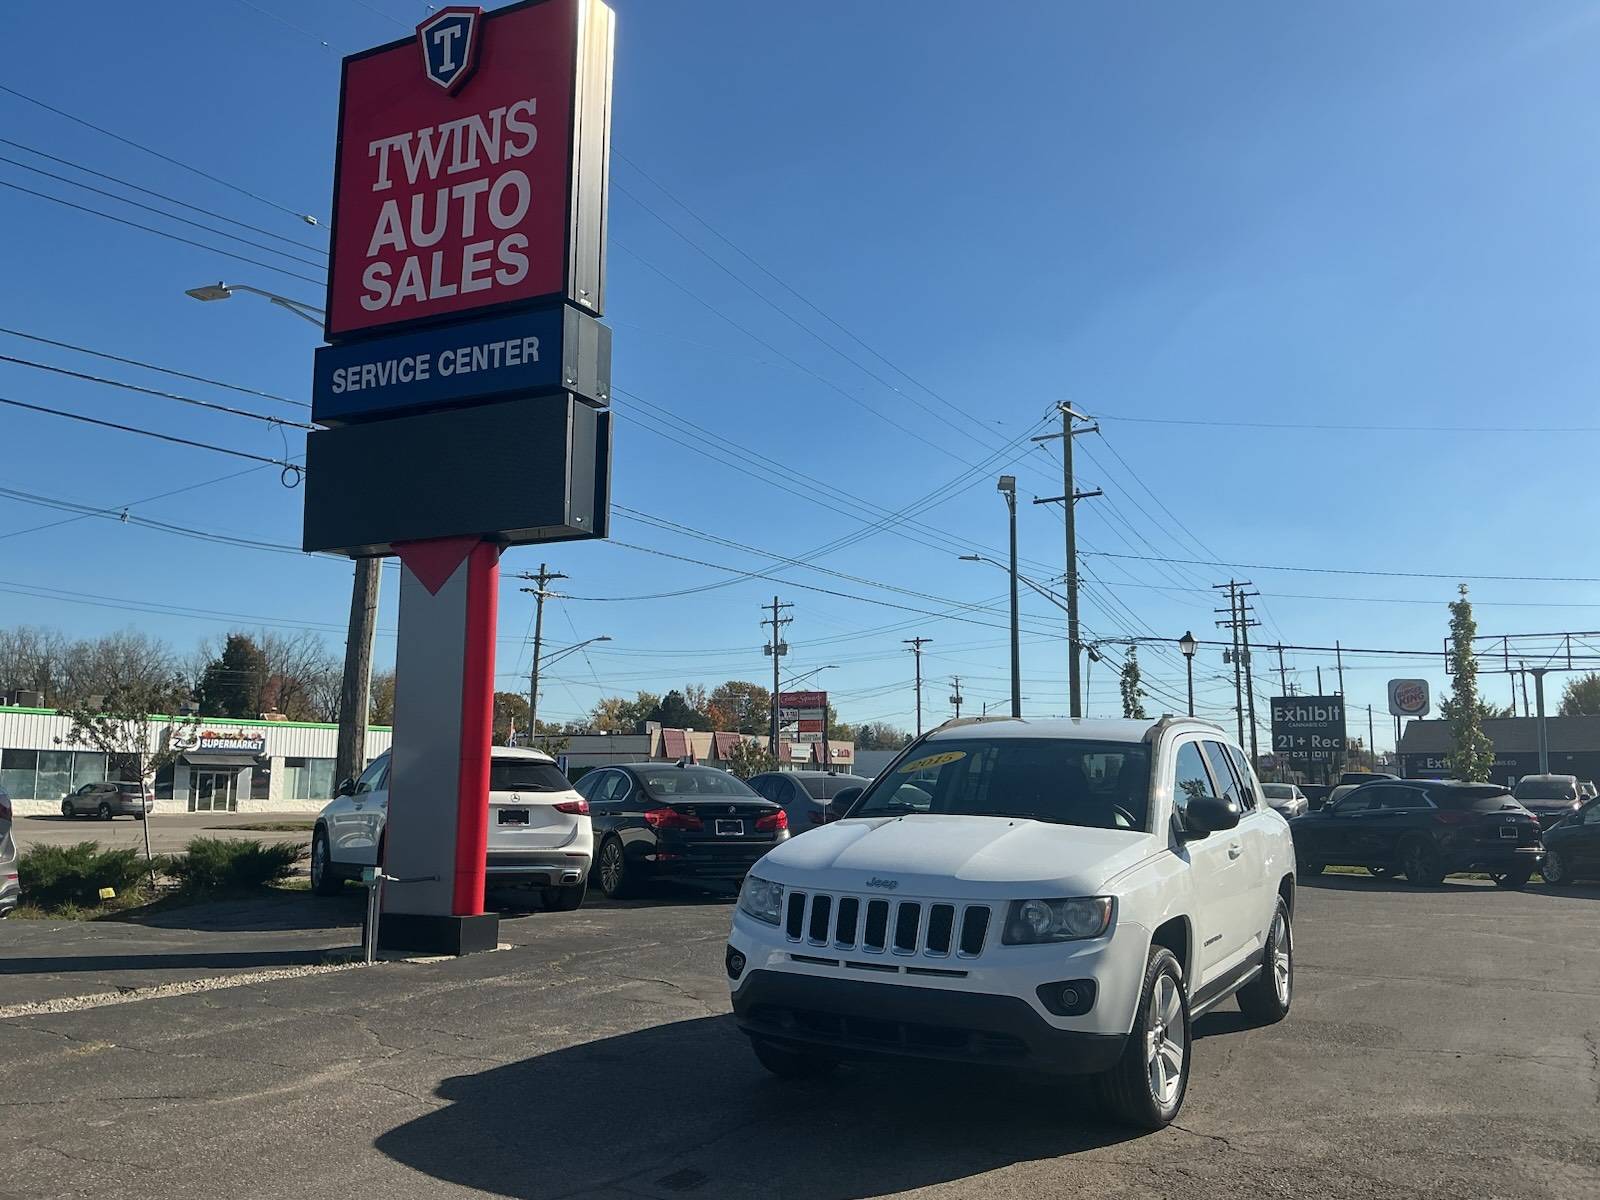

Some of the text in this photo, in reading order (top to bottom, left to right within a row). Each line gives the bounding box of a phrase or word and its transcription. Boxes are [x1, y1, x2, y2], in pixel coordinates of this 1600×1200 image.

[434, 25, 461, 73] T
[368, 98, 538, 192] TWINS
[366, 170, 531, 257] AUTO
[360, 232, 529, 312] SALES
[332, 336, 540, 394] SERVICE CENTER
[1399, 693, 1425, 705] KING
[1273, 706, 1340, 721] Exhibit
[201, 739, 263, 750] SUPERMARKET
[1278, 735, 1340, 748] 21+ Rec
[909, 755, 953, 771] 2015
[866, 877, 898, 890] Jeep
